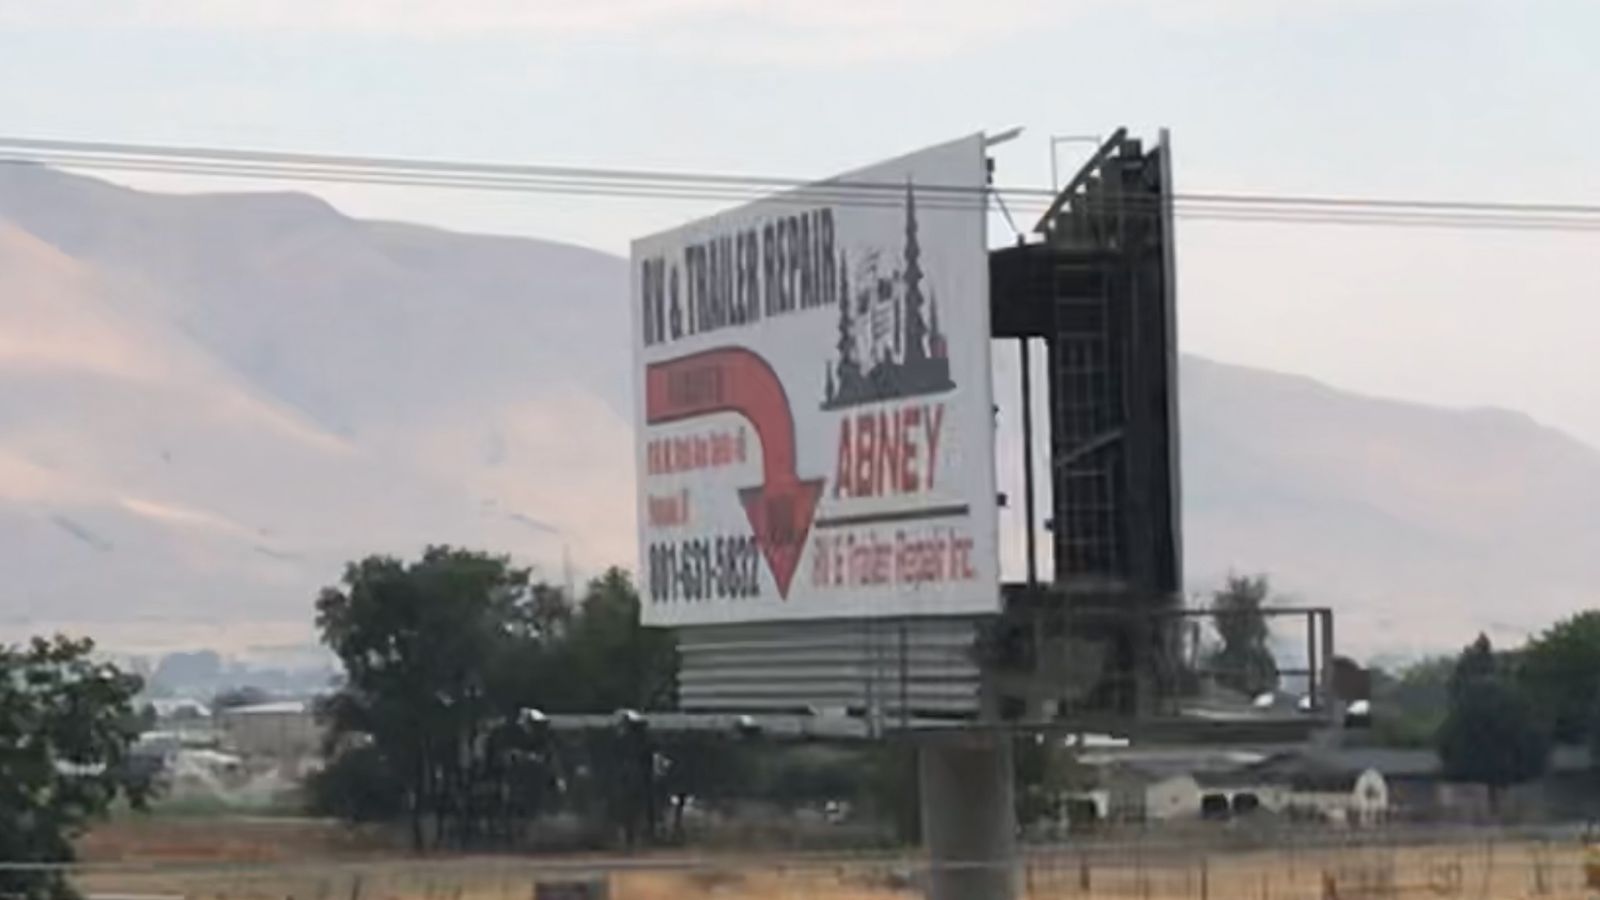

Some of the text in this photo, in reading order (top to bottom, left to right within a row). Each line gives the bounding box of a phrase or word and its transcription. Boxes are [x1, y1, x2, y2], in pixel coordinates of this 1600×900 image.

[642, 256, 667, 347] RV
[685, 228, 760, 335] TRAILER
[764, 206, 836, 318] REPAIR
[833, 402, 944, 499] ABNEY
